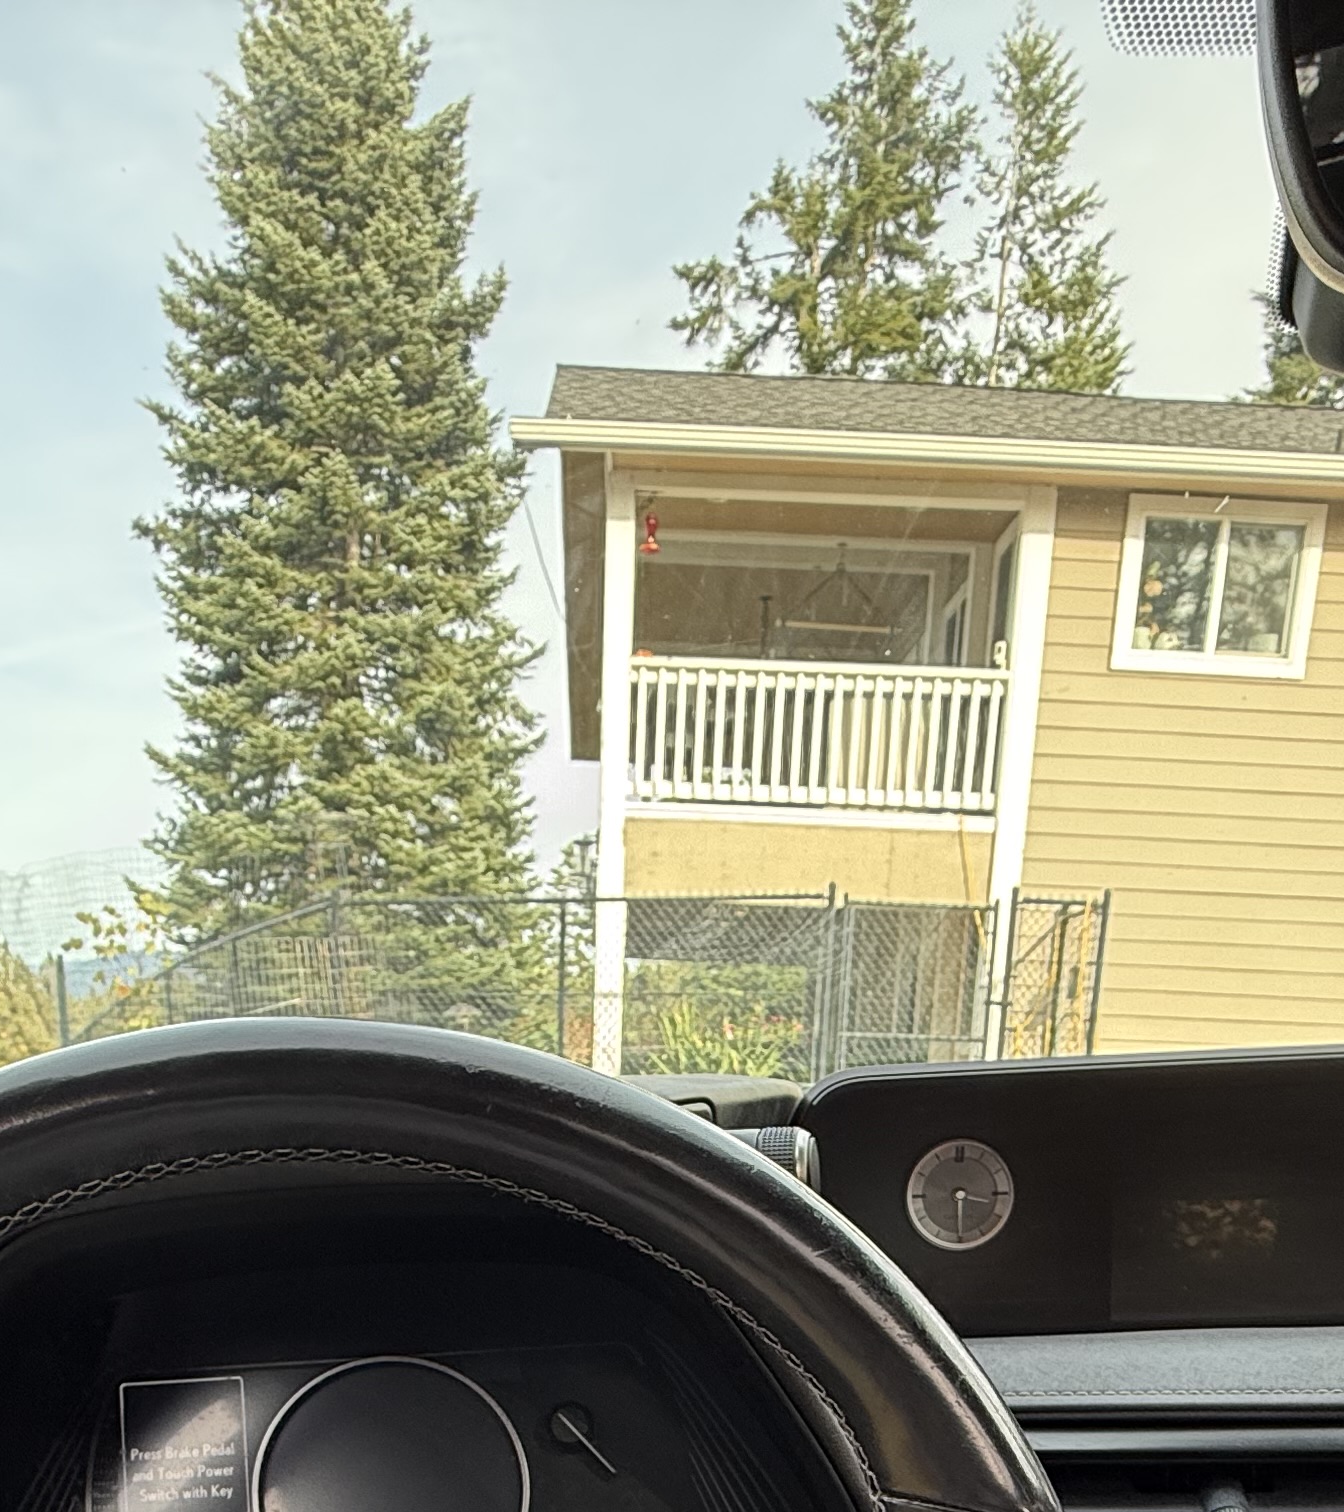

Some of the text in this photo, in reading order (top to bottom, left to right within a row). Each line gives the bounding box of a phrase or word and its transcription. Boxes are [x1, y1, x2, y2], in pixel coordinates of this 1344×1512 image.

[130, 1443, 234, 1461] Press Brake Pedal
[133, 1465, 234, 1482] and Touch Power
[139, 1484, 234, 1503] Switch with Key
